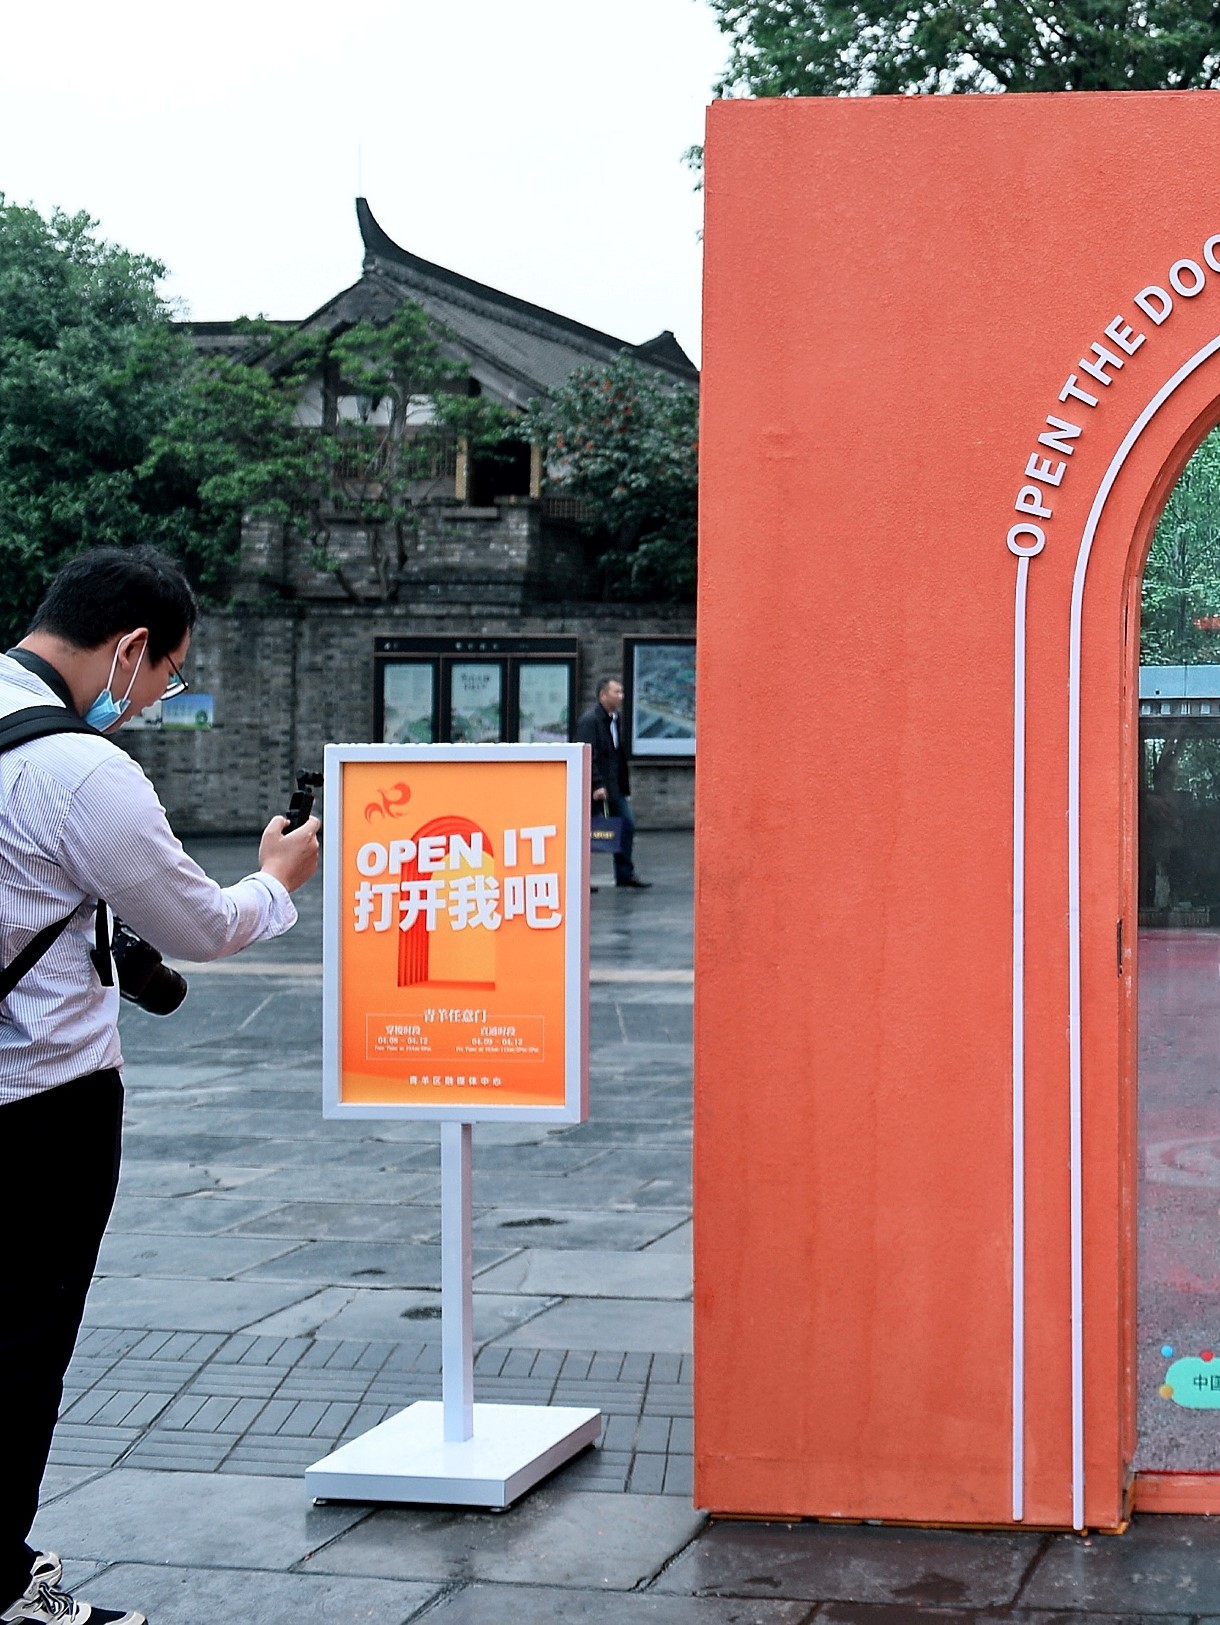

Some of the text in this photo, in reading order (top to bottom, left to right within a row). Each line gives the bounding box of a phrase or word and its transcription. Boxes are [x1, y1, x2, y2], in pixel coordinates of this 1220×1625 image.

[1006, 414, 1082, 558] OPEN
[1058, 314, 1147, 408] THE
[356, 825, 557, 877] OPEN IT
[353, 873, 563, 933] 打开我吧
[423, 1008, 487, 1024] 青羊任意门
